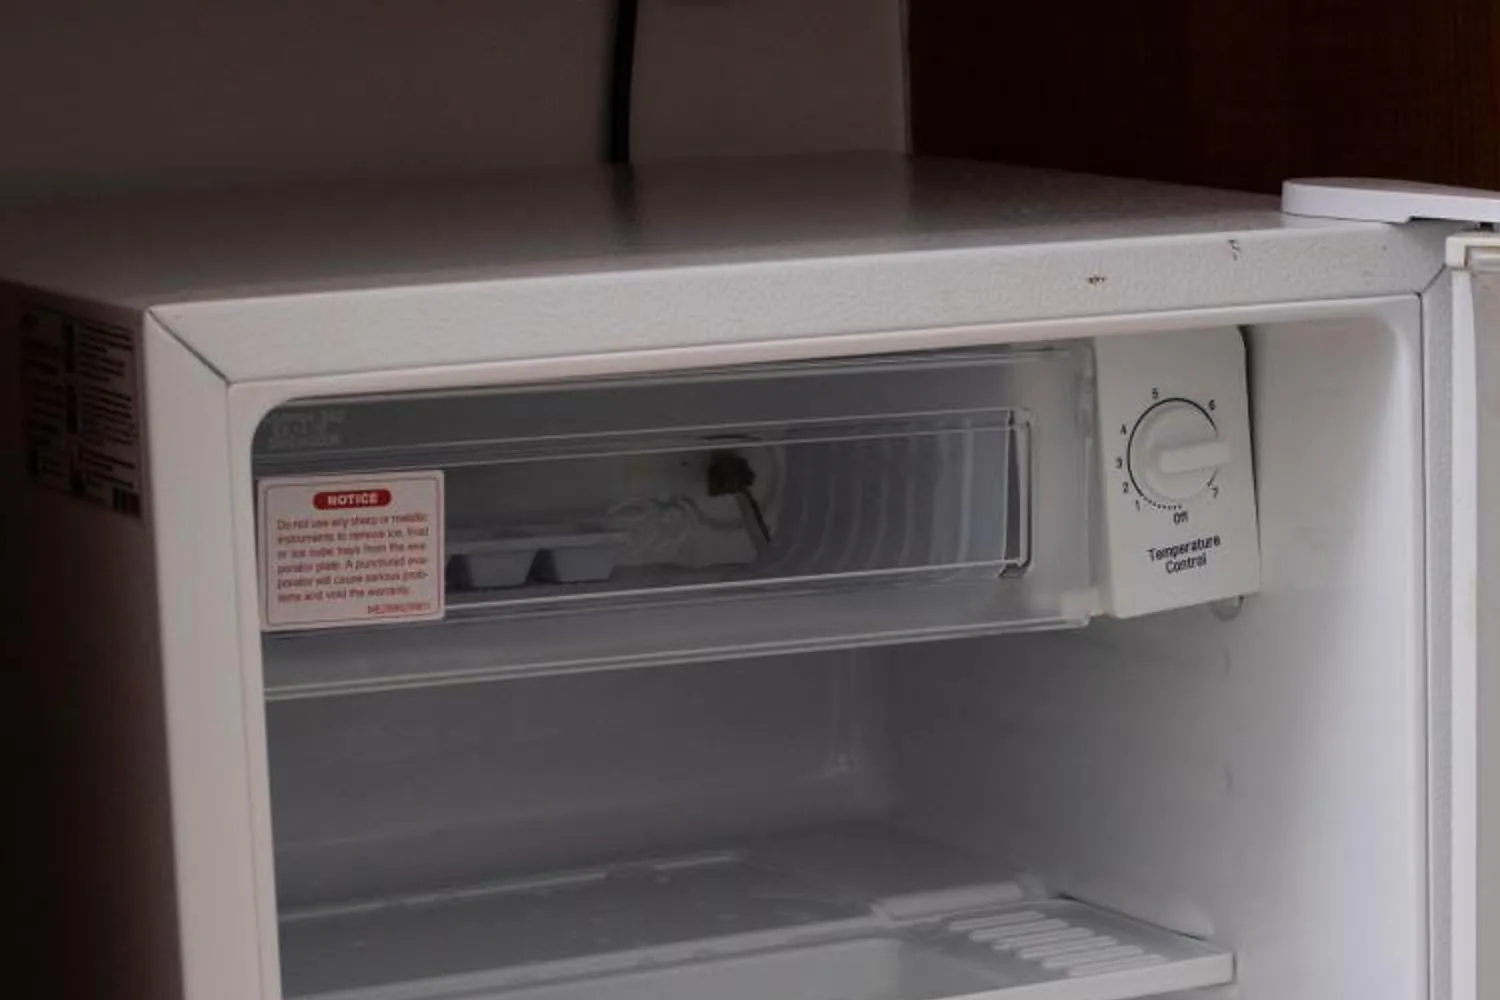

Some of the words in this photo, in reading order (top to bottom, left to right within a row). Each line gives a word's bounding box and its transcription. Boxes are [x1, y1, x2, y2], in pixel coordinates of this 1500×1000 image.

[327, 492, 379, 506] NOTICE
[1147, 534, 1221, 562] Temperature
[1165, 552, 1207, 574] Control
